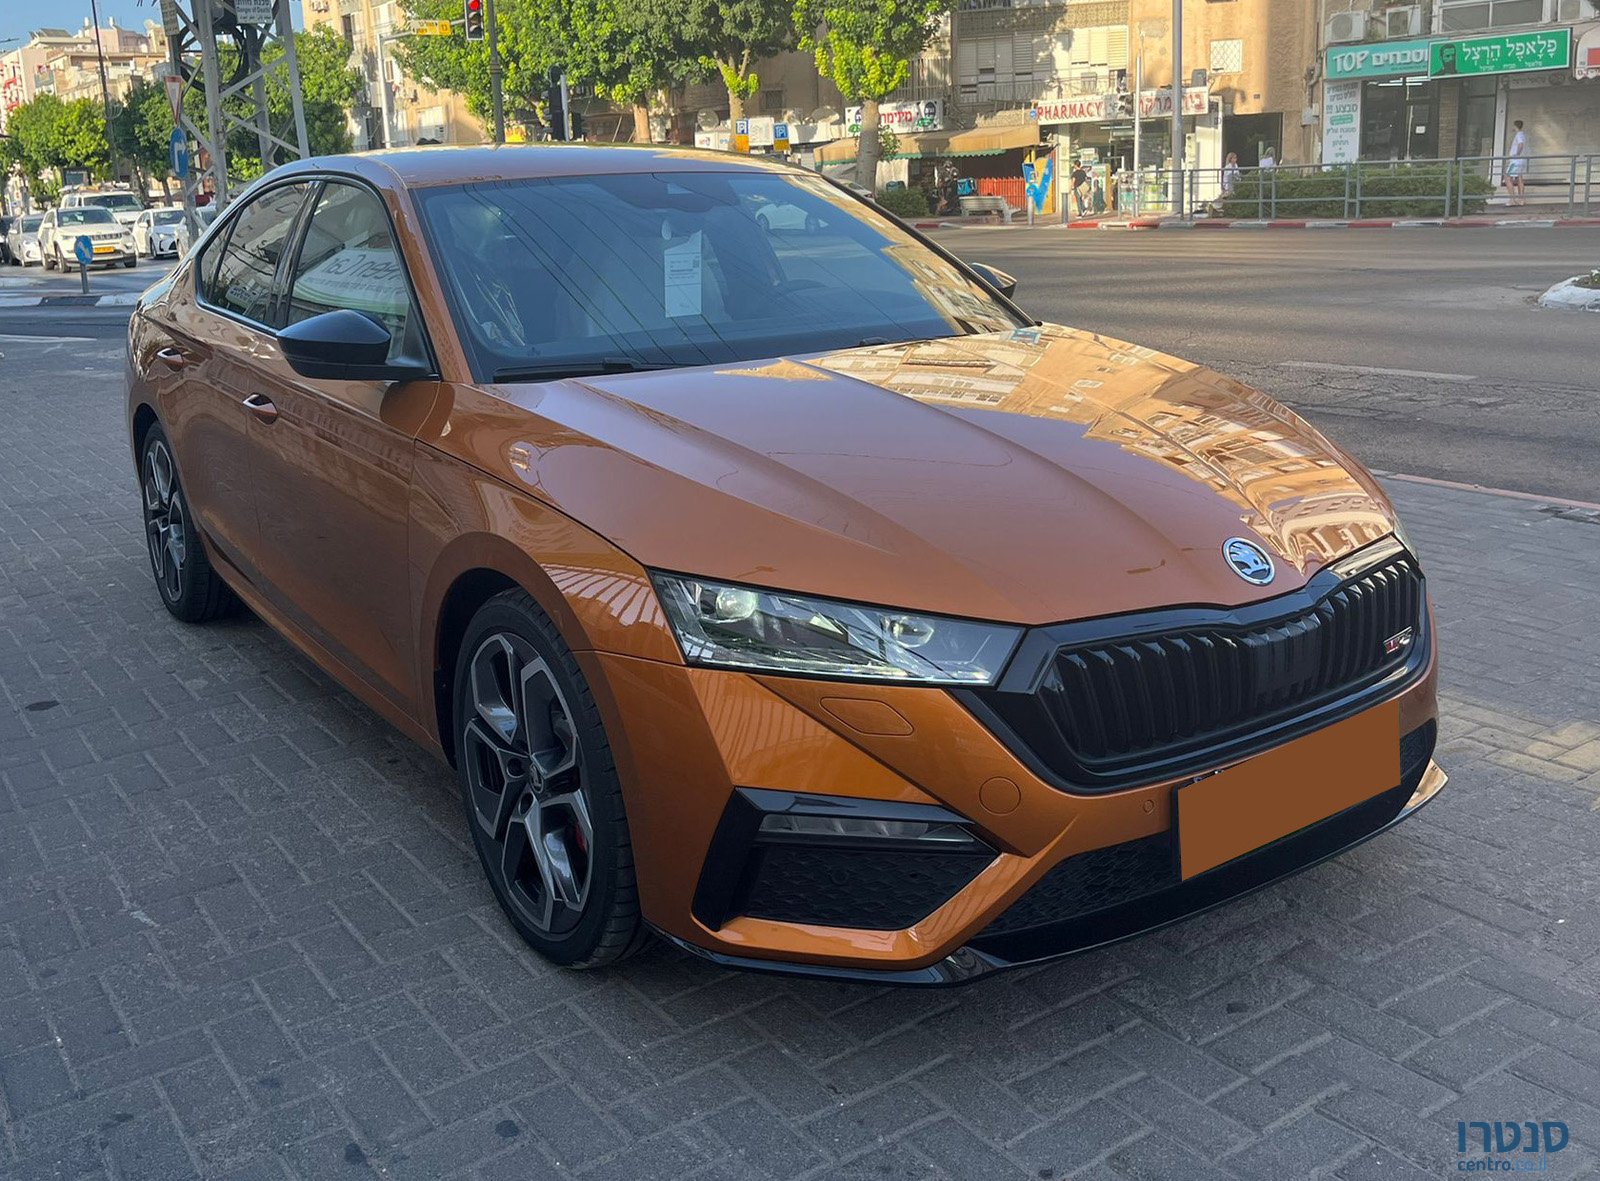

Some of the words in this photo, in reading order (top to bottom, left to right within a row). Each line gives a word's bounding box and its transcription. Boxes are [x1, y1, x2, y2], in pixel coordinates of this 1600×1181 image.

[1332, 50, 1369, 72] TOP
[1372, 48, 1428, 66] טבחים
[880, 110, 913, 124] מינימר
[1037, 102, 1103, 120] PHARMACY
